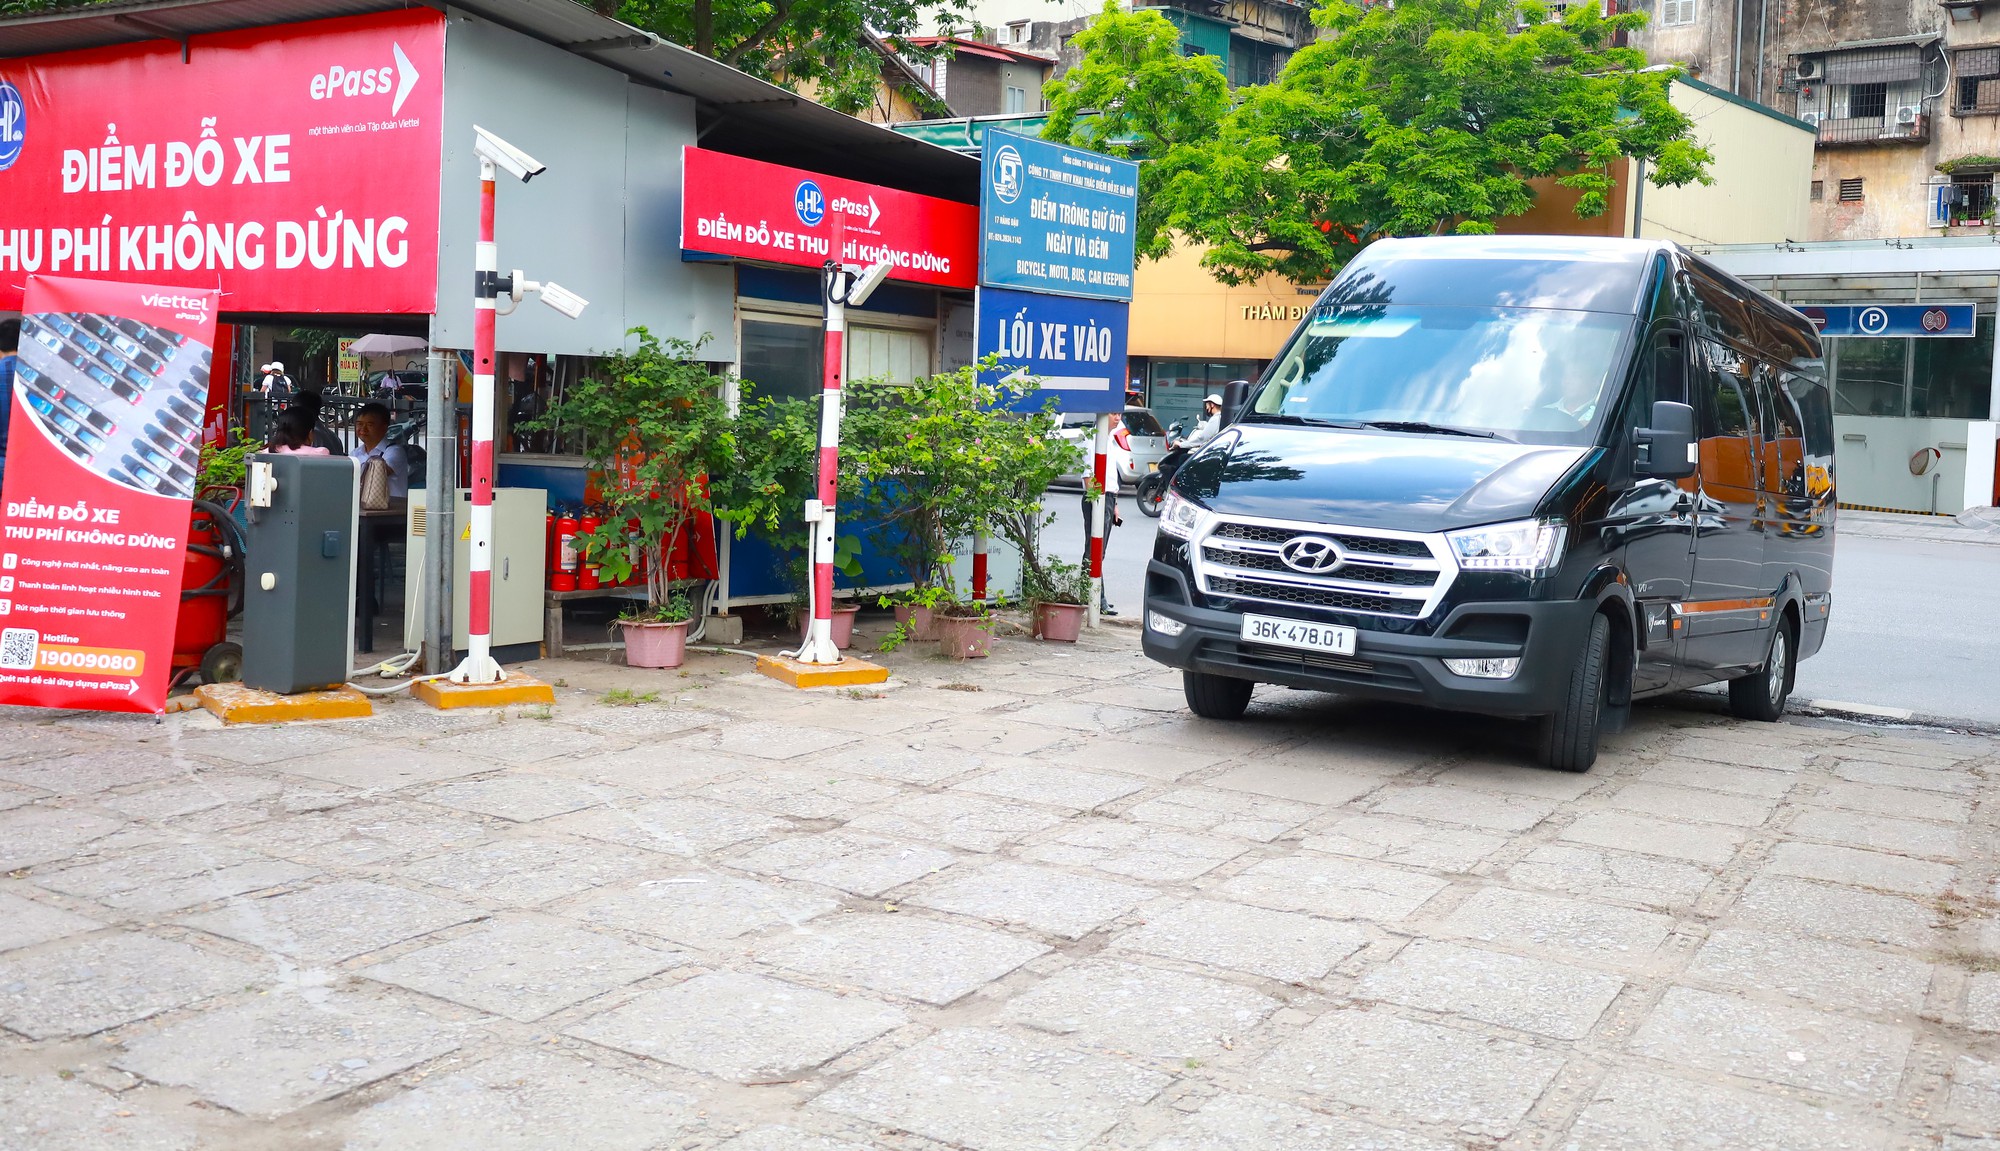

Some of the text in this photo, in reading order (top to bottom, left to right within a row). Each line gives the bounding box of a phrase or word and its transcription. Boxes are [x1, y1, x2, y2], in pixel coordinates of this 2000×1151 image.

[310, 65, 393, 100] ePass
[309, 118, 419, 136] một thành viên của Tập đoàn Viettel
[61, 116, 291, 193] ĐIỂM ĐỖ XE
[1028, 163, 1042, 176] CÔNG
[1043, 167, 1048, 178] TY
[831, 197, 869, 217] ePass
[1031, 192, 1056, 222] ĐIỂM
[1059, 201, 1089, 228] TRÔNG
[1109, 209, 1126, 234] ÔTÔ
[0, 205, 409, 272] HU PHÍ KHÔNG DỪNG
[697, 212, 950, 273] ĐIỂM ĐỖ XE THU HÍ KHÔNG DỪNG
[1046, 230, 1109, 260] NGÀY VÀ ĐÊM
[1016, 259, 1129, 287] BICYCLE, MOTO, BUS, CAR KEEPING
[141, 293, 209, 311] viettel
[1240, 301, 1286, 320] THẨM
[175, 312, 201, 321] ePass
[1869, 314, 1880, 326] P
[999, 307, 1112, 363] LỐI XE VÀO
[7, 497, 120, 524] ĐIỂM ĐỖ XE
[5, 526, 176, 550] THU PHÍ KHÔNG DỪNG
[21, 558, 41, 568] Công
[42, 560, 62, 568] nghệ
[63, 561, 79, 569] mới
[80, 562, 100, 571] nhất,
[102, 564, 122, 573] nâng
[151, 567, 170, 575] toàn
[18, 581, 41, 589] Thanh
[42, 582, 60, 590] toán
[78, 585, 97, 594] hoạt
[98, 586, 121, 595] nhiều
[122, 588, 141, 596] hình
[142, 589, 161, 598] thức
[30, 605, 49, 613] ngắn
[50, 606, 66, 614] thời
[67, 608, 85, 616] gian
[101, 609, 126, 619] thông
[43, 633, 79, 644] Hotline
[1252, 620, 1343, 648] 36K-478.01
[40, 650, 137, 671] 19009080
[17, 675, 30, 683] mã
[31, 674, 42, 684] để
[43, 677, 56, 685] cài
[57, 678, 74, 688] ứng
[75, 680, 98, 689] dụng
[100, 681, 131, 691] ePass
